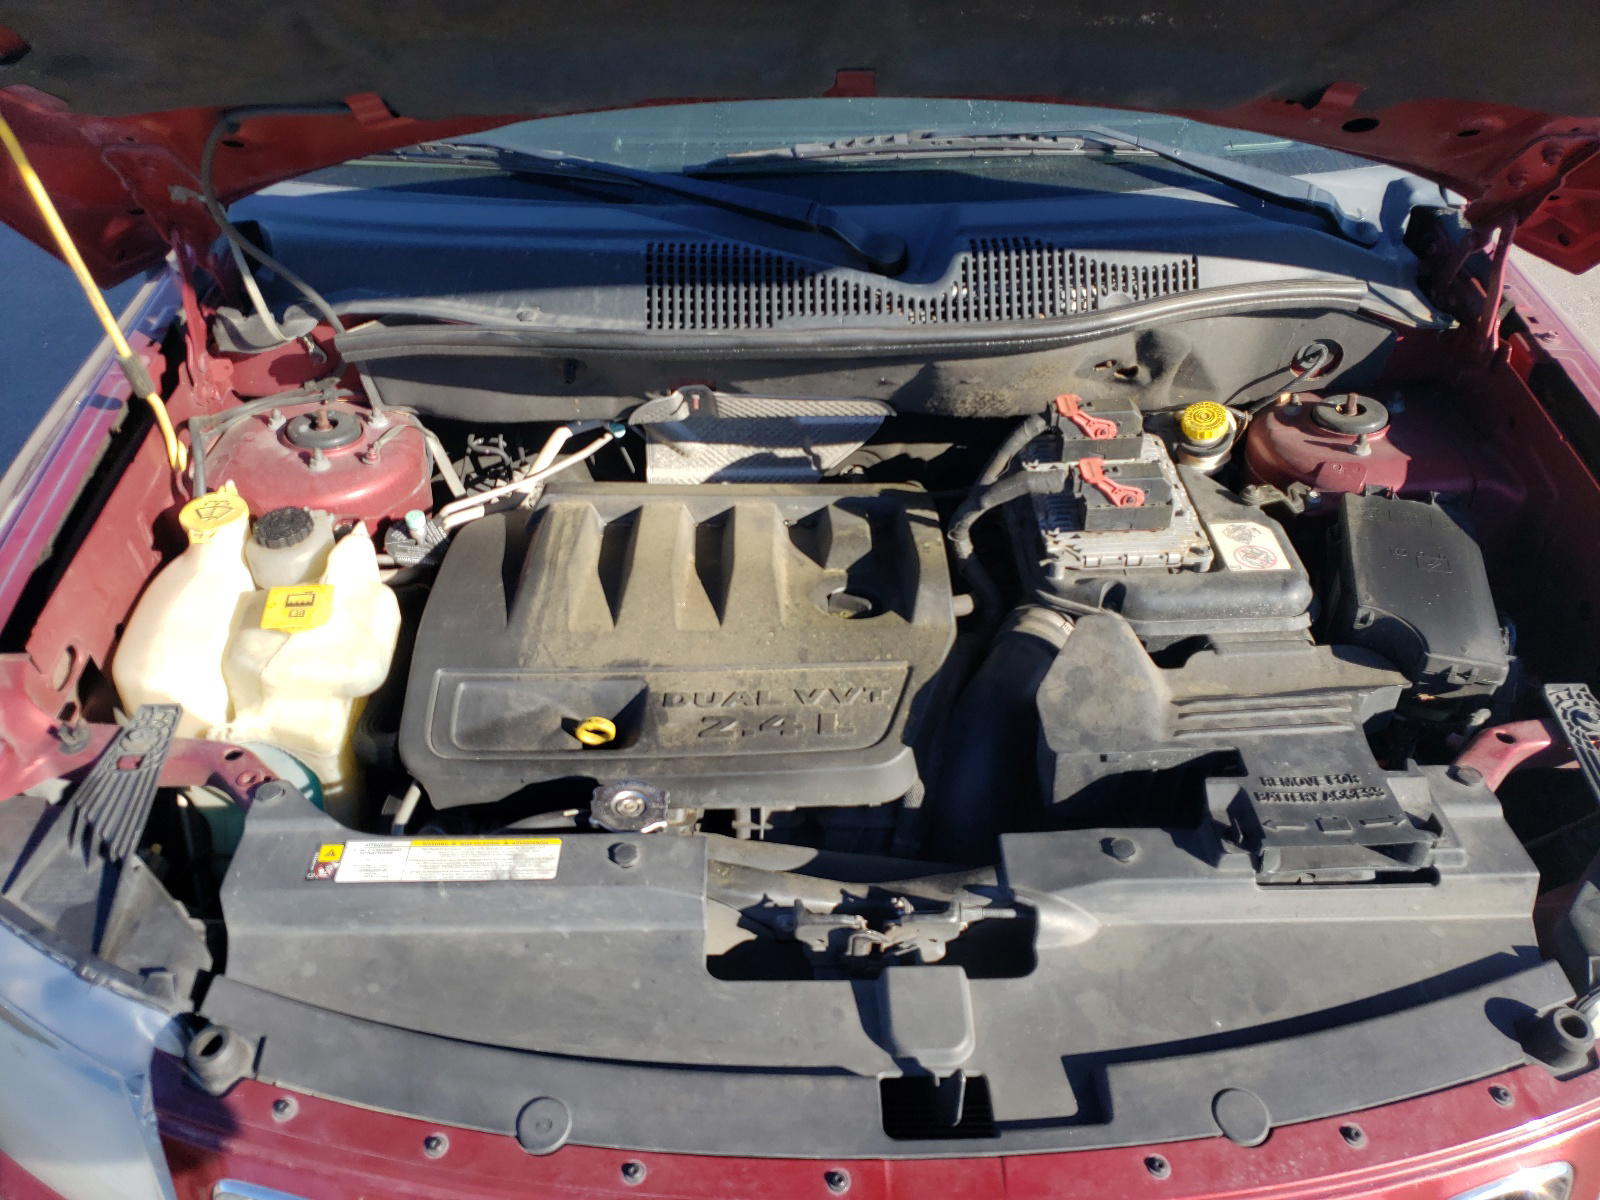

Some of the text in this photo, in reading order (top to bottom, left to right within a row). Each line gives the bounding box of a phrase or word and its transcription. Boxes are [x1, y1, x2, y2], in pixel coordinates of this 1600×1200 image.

[662, 687, 893, 708] DUAL VVT
[1323, 774, 1361, 785] FOR
